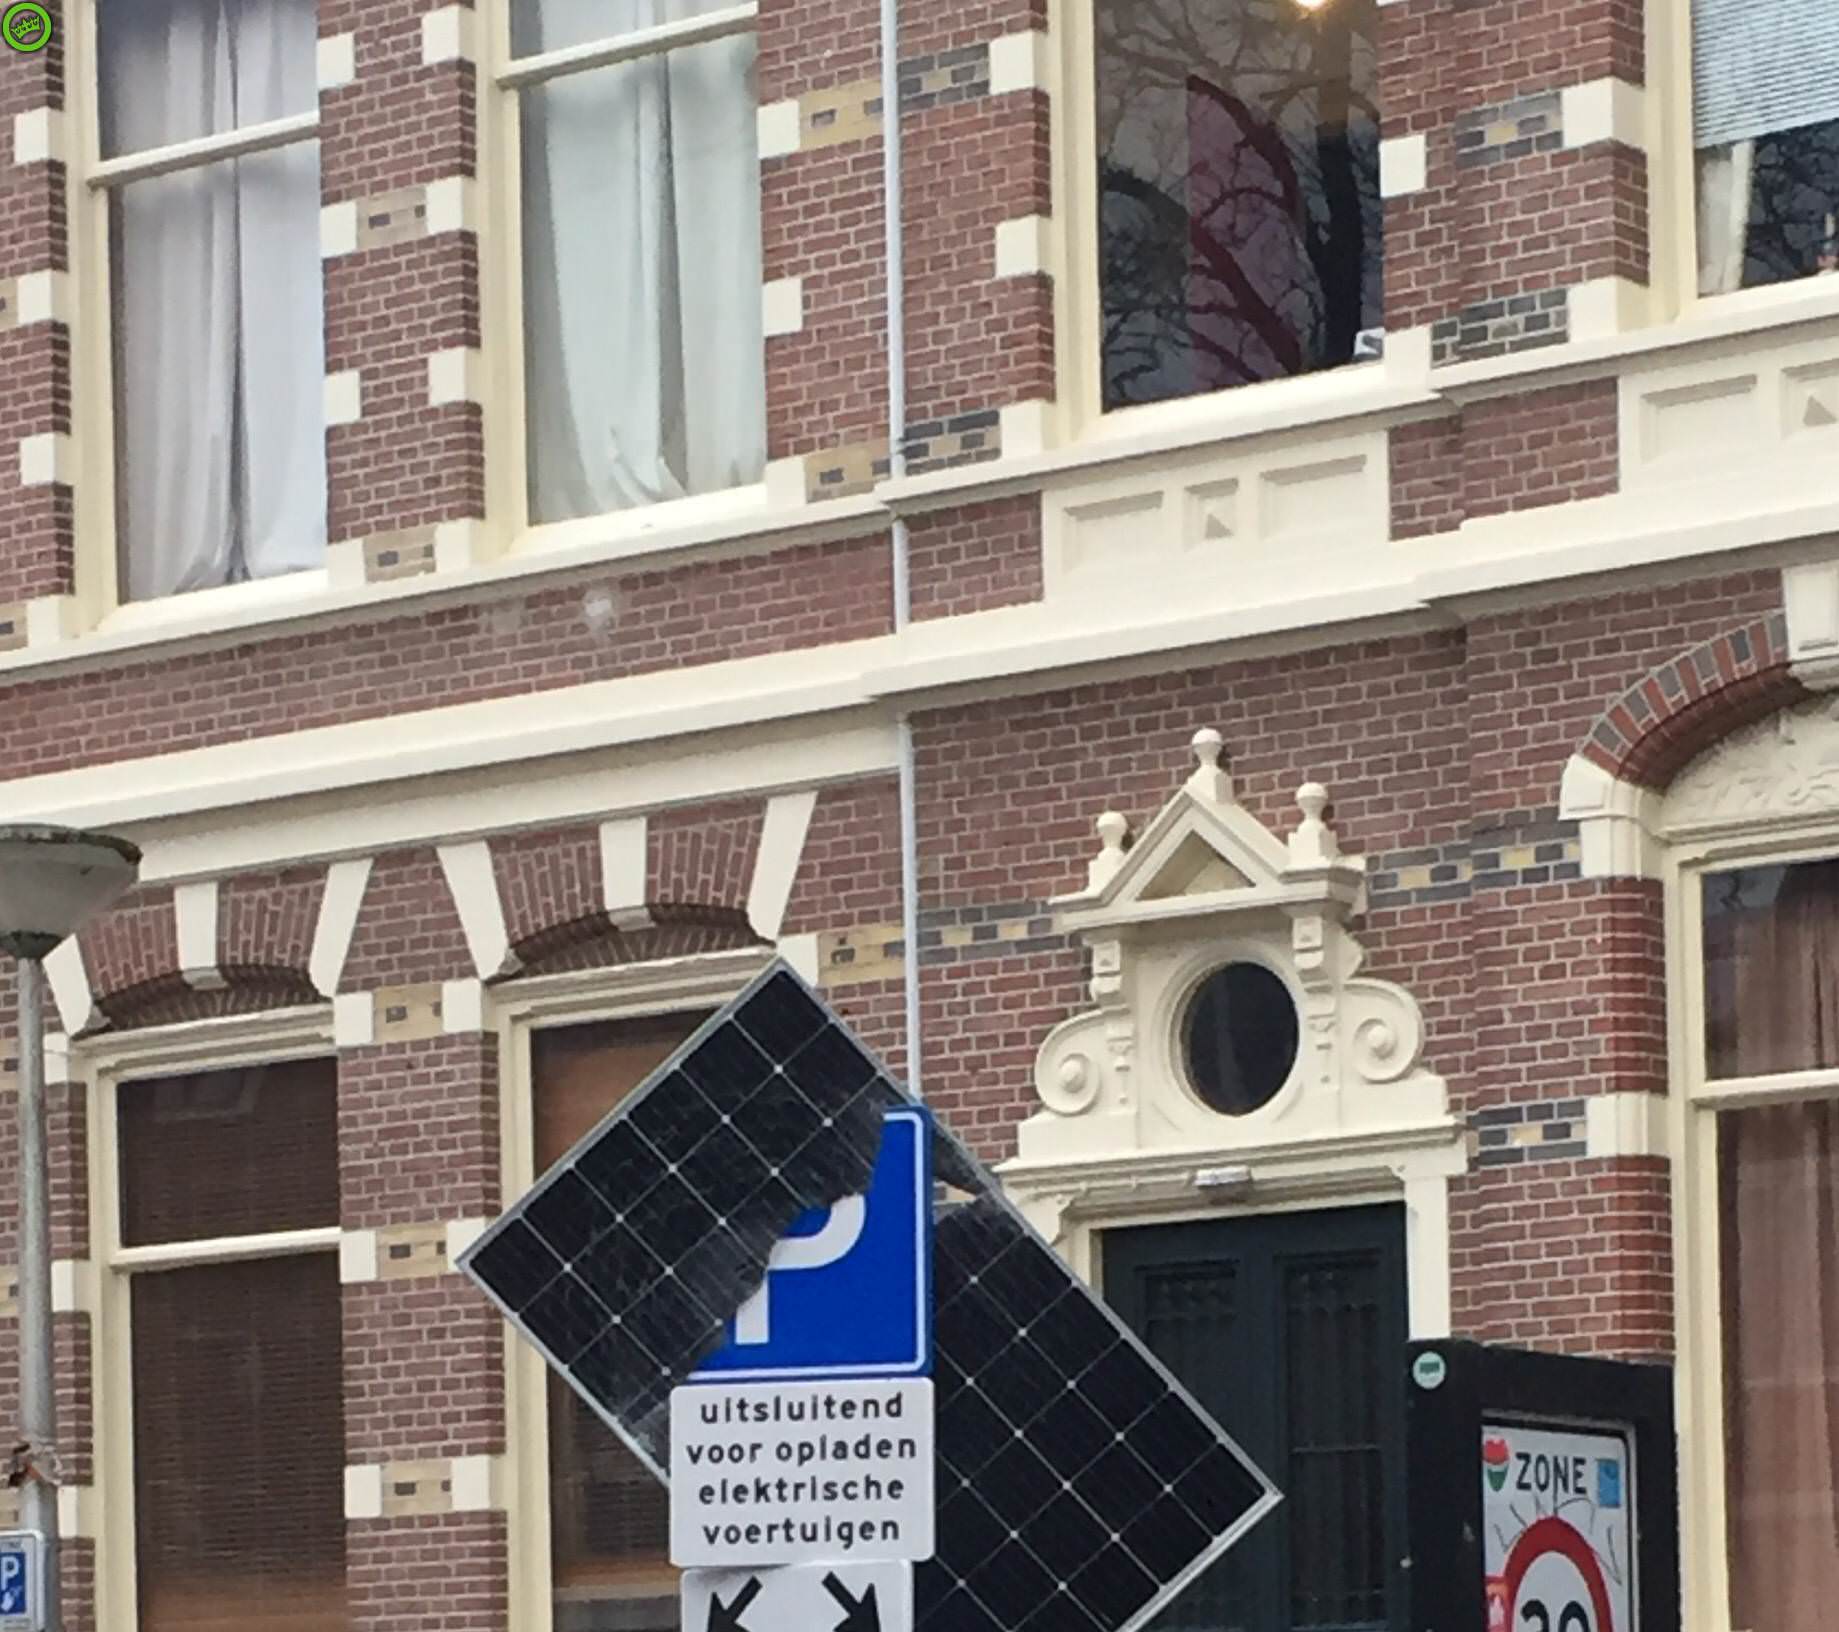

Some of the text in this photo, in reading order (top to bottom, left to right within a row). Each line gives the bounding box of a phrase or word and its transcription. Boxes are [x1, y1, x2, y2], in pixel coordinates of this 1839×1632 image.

[700, 1392, 903, 1425] uitsluitend
[685, 1433, 917, 1467] voor opladen
[698, 1474, 905, 1506] elektrische
[1514, 1450, 1588, 1496] ZONE
[702, 1516, 900, 1551] voertuigen
[1, 1556, 19, 1591] P
